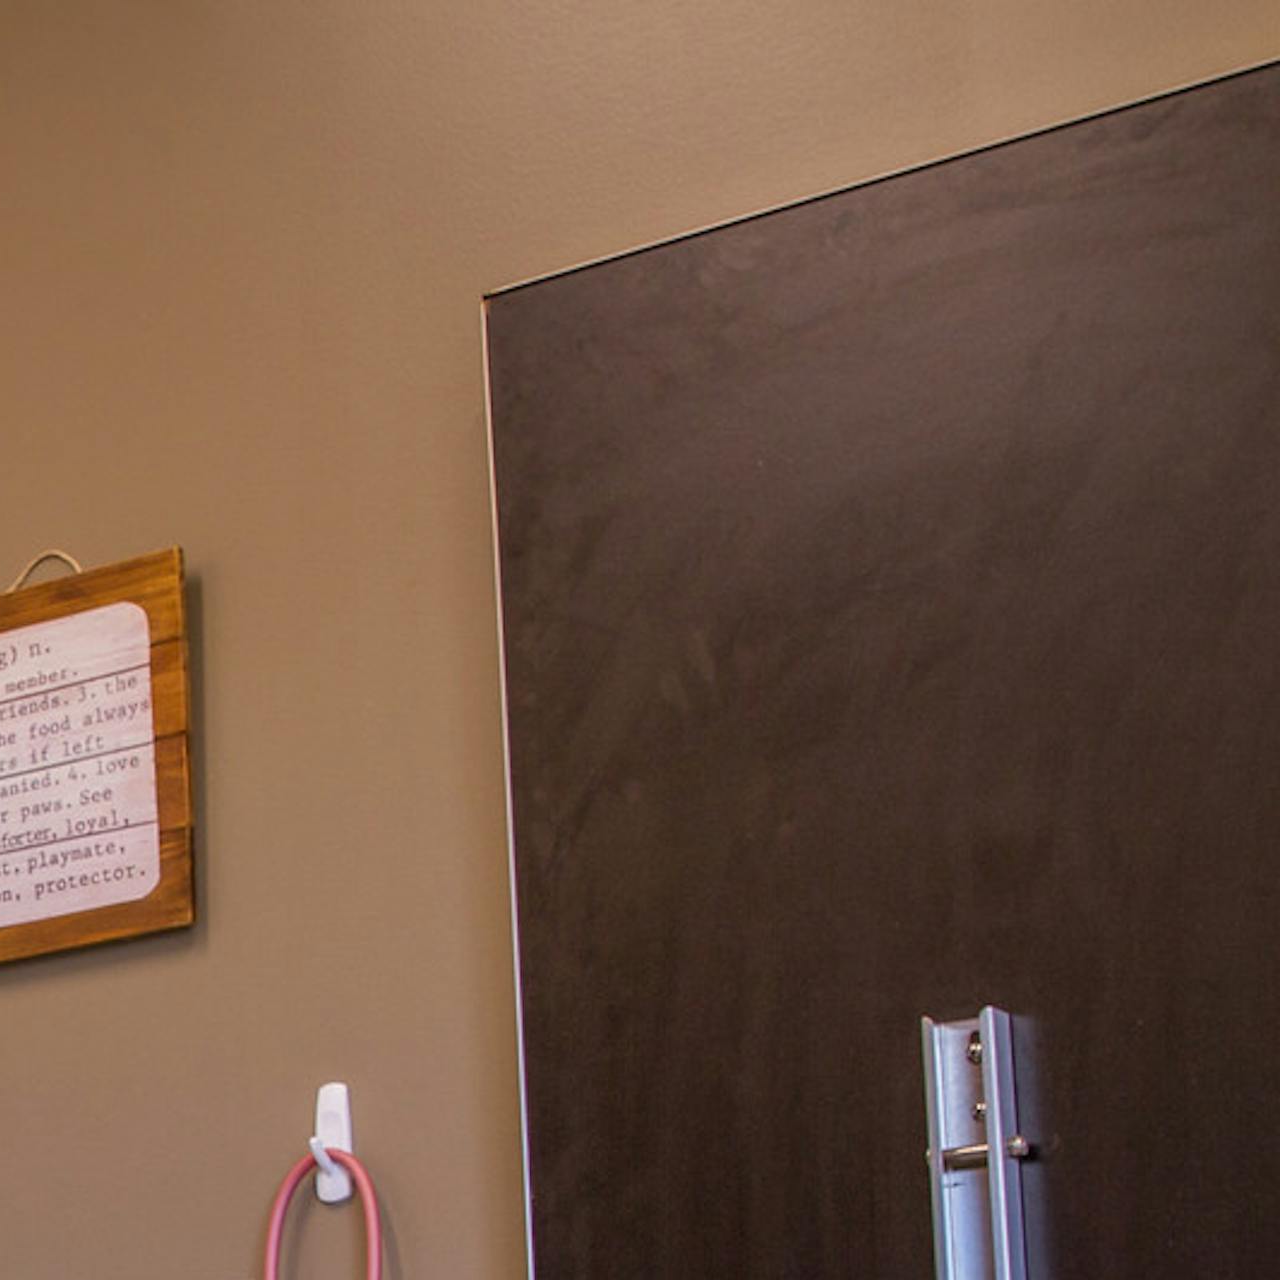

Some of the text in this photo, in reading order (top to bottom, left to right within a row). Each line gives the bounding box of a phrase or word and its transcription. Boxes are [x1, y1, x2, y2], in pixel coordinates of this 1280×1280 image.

[29, 641, 51, 658] n.
[5, 667, 78, 693] member.
[105, 672, 138, 694] the
[28, 716, 71, 740] food
[82, 697, 149, 727] always
[30, 744, 48, 764] if
[62, 734, 105, 757] left
[95, 753, 140, 777] love
[20, 797, 73, 818] paws.
[79, 786, 113, 807] See
[34, 861, 146, 896] protector.
